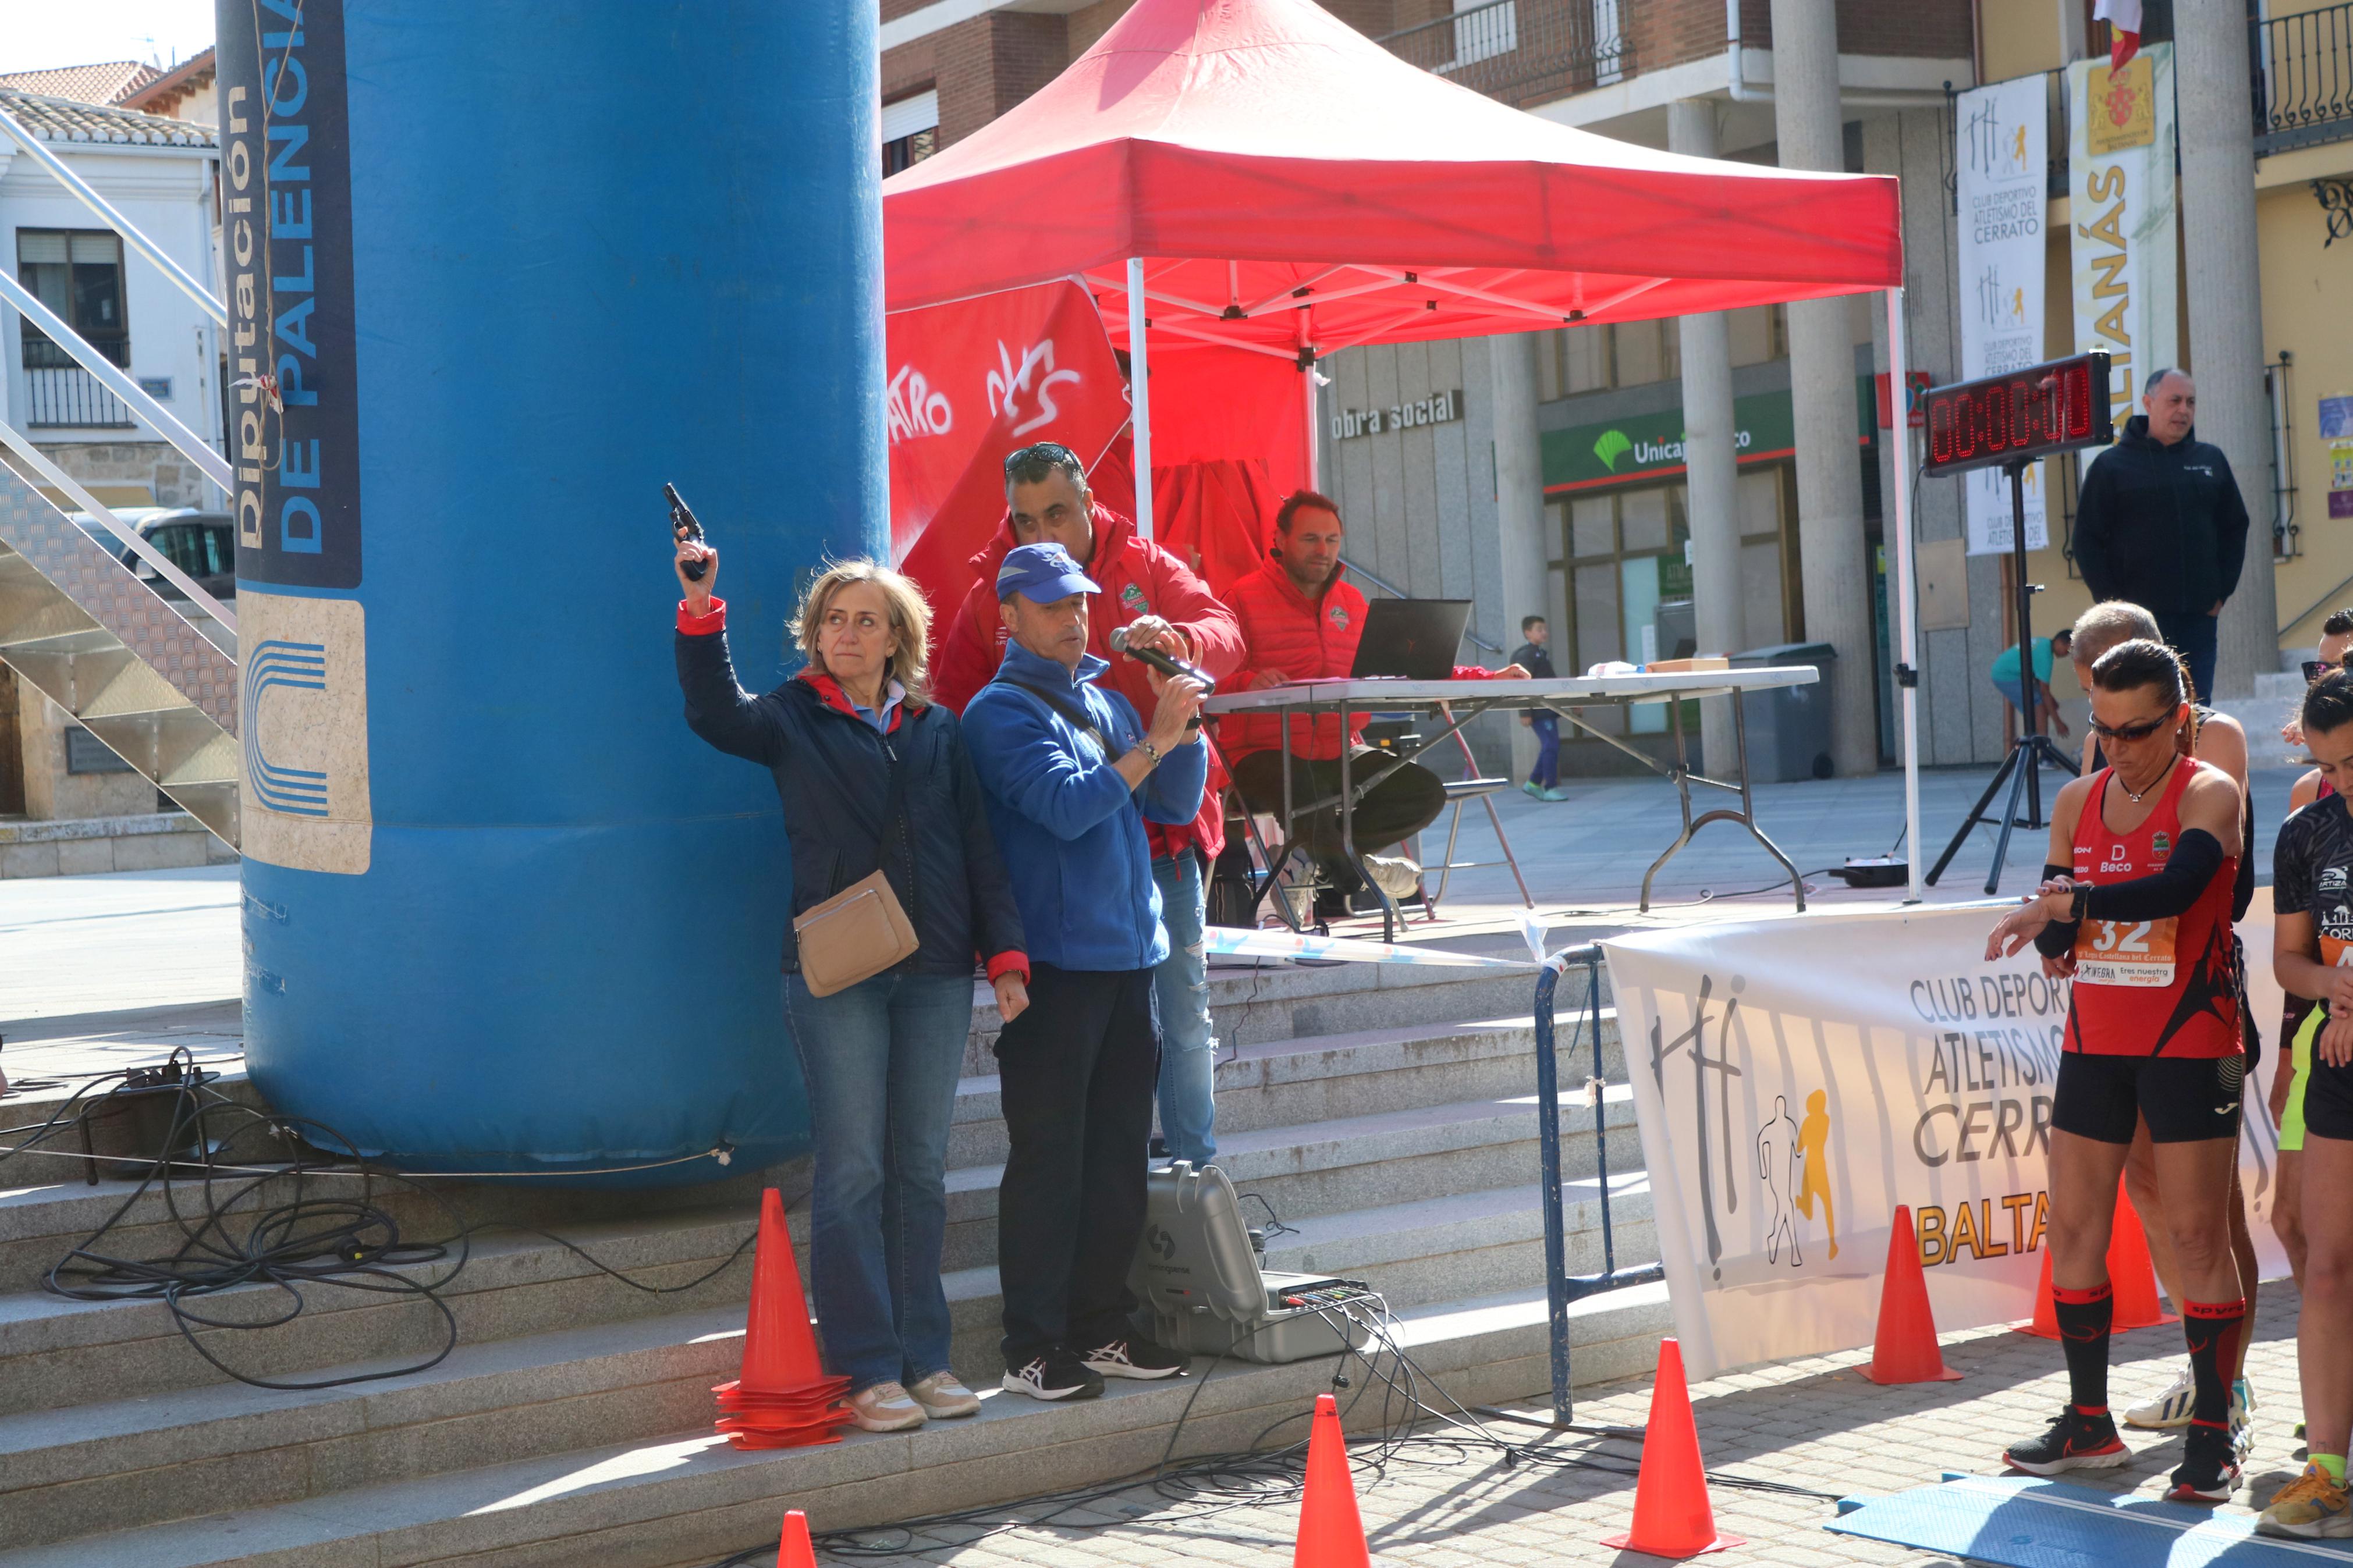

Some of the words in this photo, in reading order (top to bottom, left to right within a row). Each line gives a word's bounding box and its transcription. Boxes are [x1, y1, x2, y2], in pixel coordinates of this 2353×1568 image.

[1972, 195, 1992, 209] CLUB
[1993, 186, 2036, 205] DEPORTIVO
[1974, 203, 2017, 225] ATLETISMO
[2020, 201, 2037, 218] DEL
[1974, 218, 2039, 244] CERRATO
[228, 86, 267, 549] Diputación
[1997, 336, 2032, 350] DEPORTIVO
[1985, 349, 2017, 364] ATLETISMO
[2020, 347, 2032, 361] DEL
[1331, 409, 1381, 439] obra
[1390, 389, 1454, 430] social
[280, 439, 322, 554] DE
[2100, 862, 2132, 873] Beco
[2092, 920, 2152, 952] 32
[2099, 952, 2130, 961] Castellana
[2137, 968, 2168, 977] nuestra
[1910, 977, 1977, 1023] CLUB
